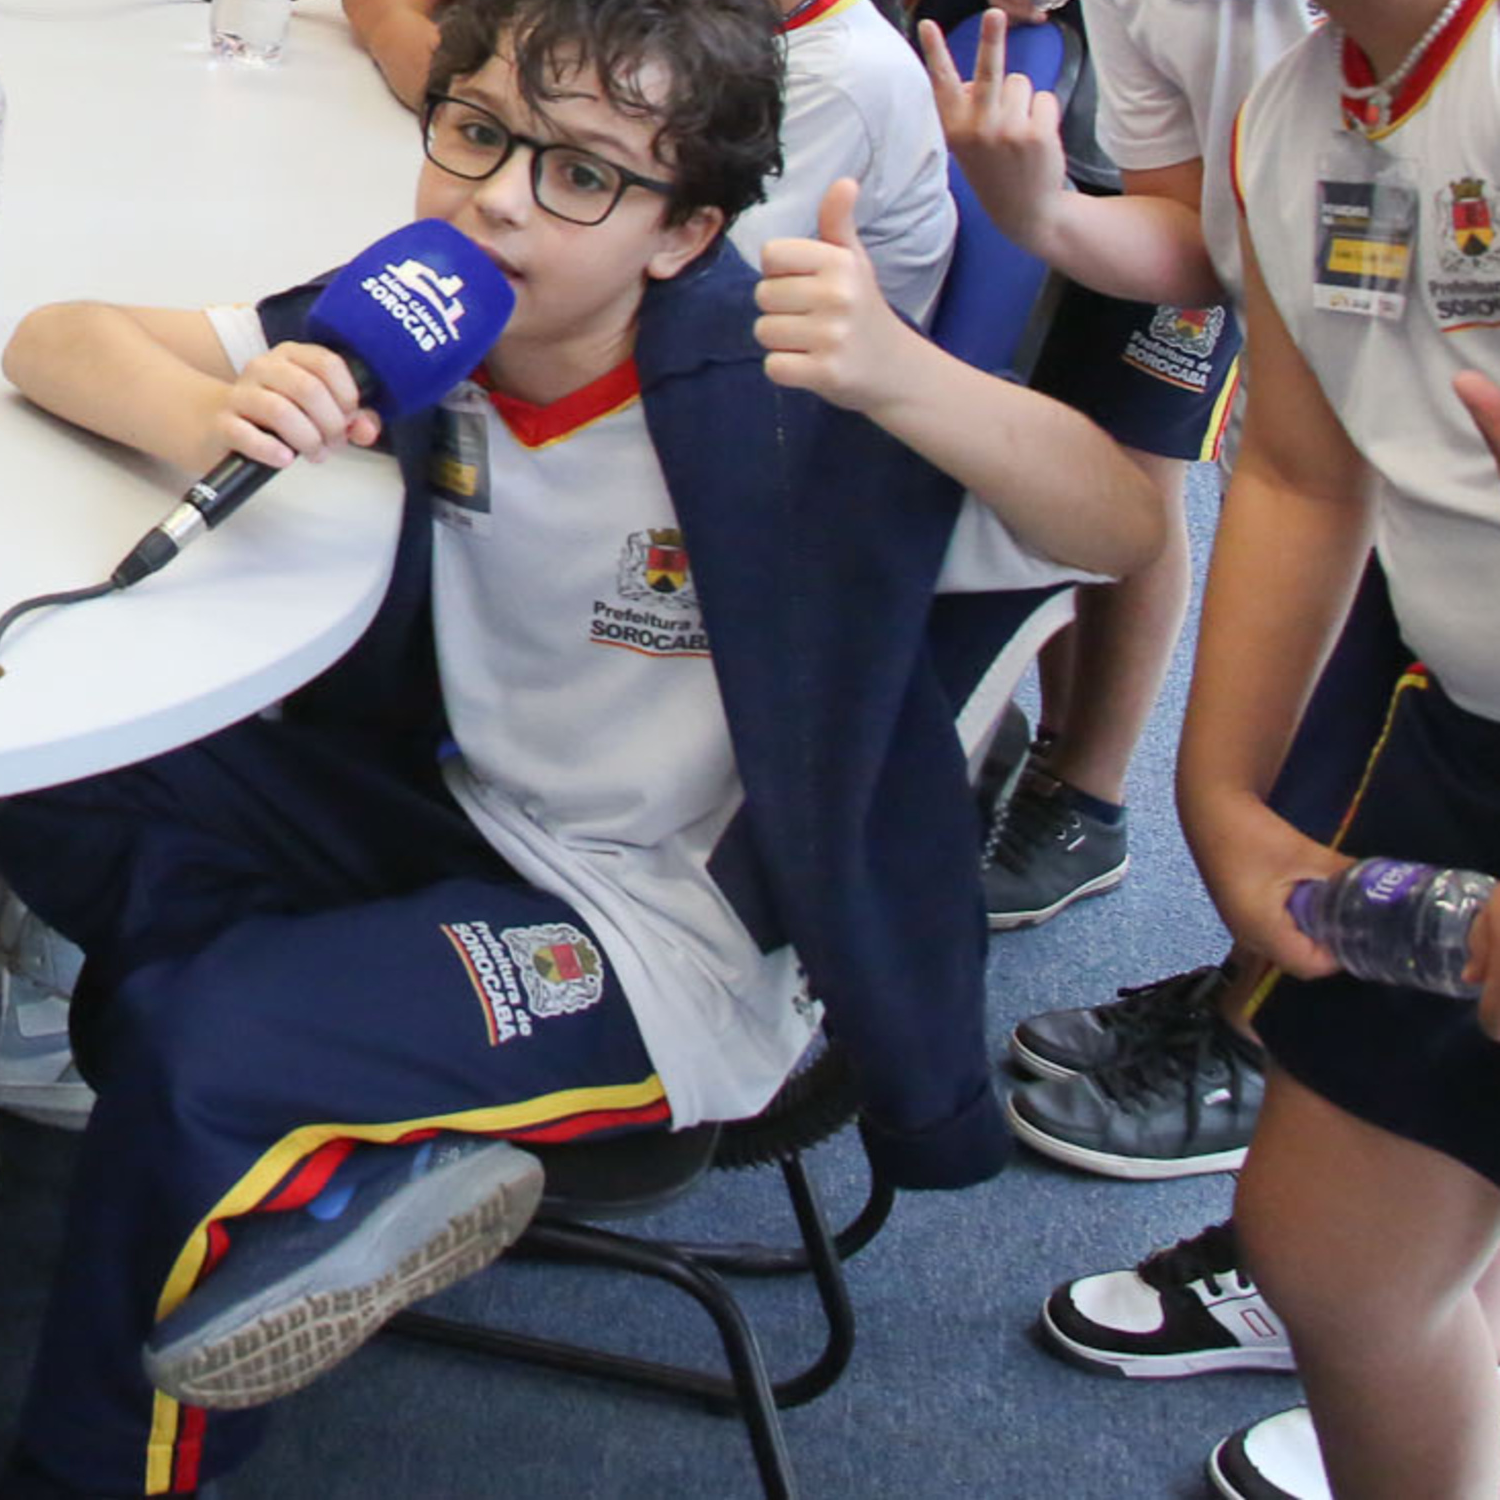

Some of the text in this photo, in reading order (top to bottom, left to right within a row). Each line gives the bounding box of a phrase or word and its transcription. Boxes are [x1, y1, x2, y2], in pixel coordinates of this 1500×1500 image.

[1124, 342, 1207, 387] SOROCABA
[590, 619, 709, 651] SOROCAB
[593, 600, 691, 632] Prefeitura
[451, 922, 517, 1043] SOROCABA
[470, 921, 532, 1037] Prefeitura de
